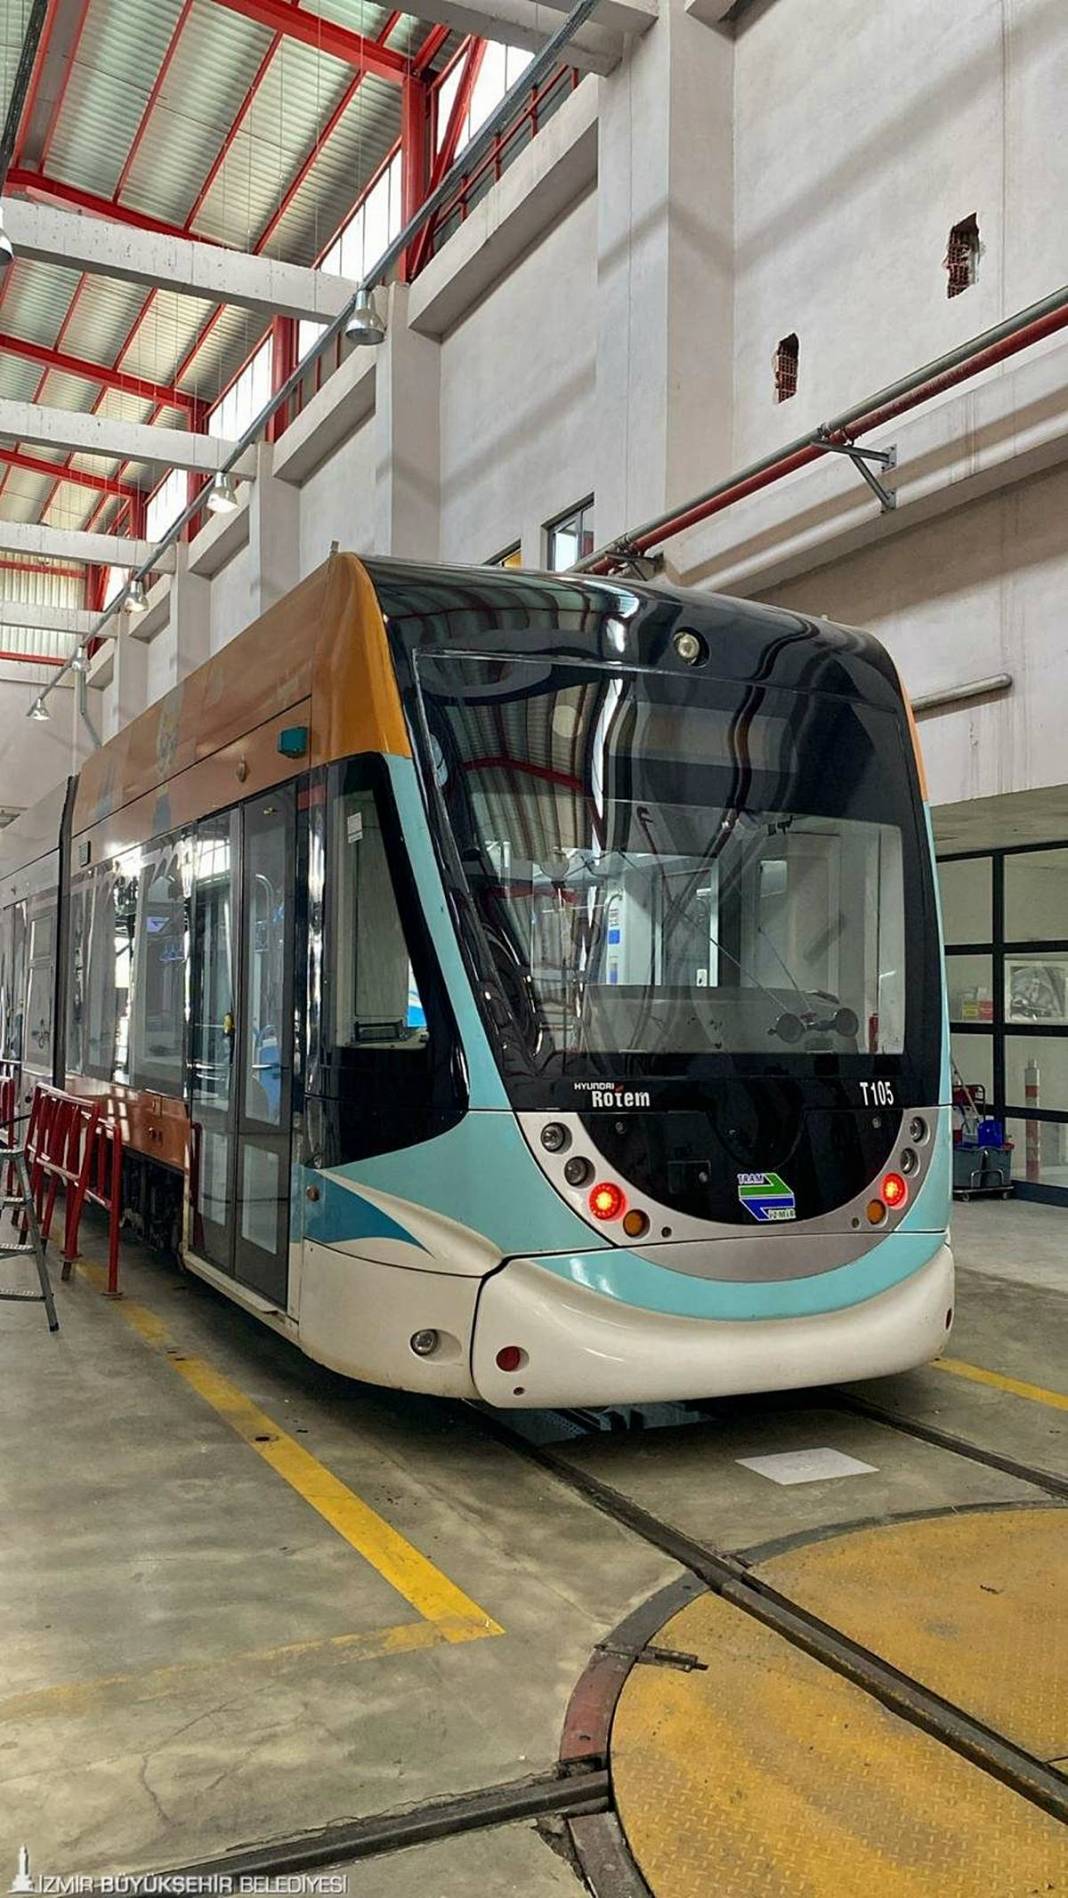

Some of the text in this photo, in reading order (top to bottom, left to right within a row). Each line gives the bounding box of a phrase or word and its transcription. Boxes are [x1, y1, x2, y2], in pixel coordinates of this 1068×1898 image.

[574, 1082, 615, 1090] HYUNDAI
[859, 1080, 894, 1106] T105
[591, 1090, 650, 1107] Rotem
[737, 1173, 765, 1184] TRAM
